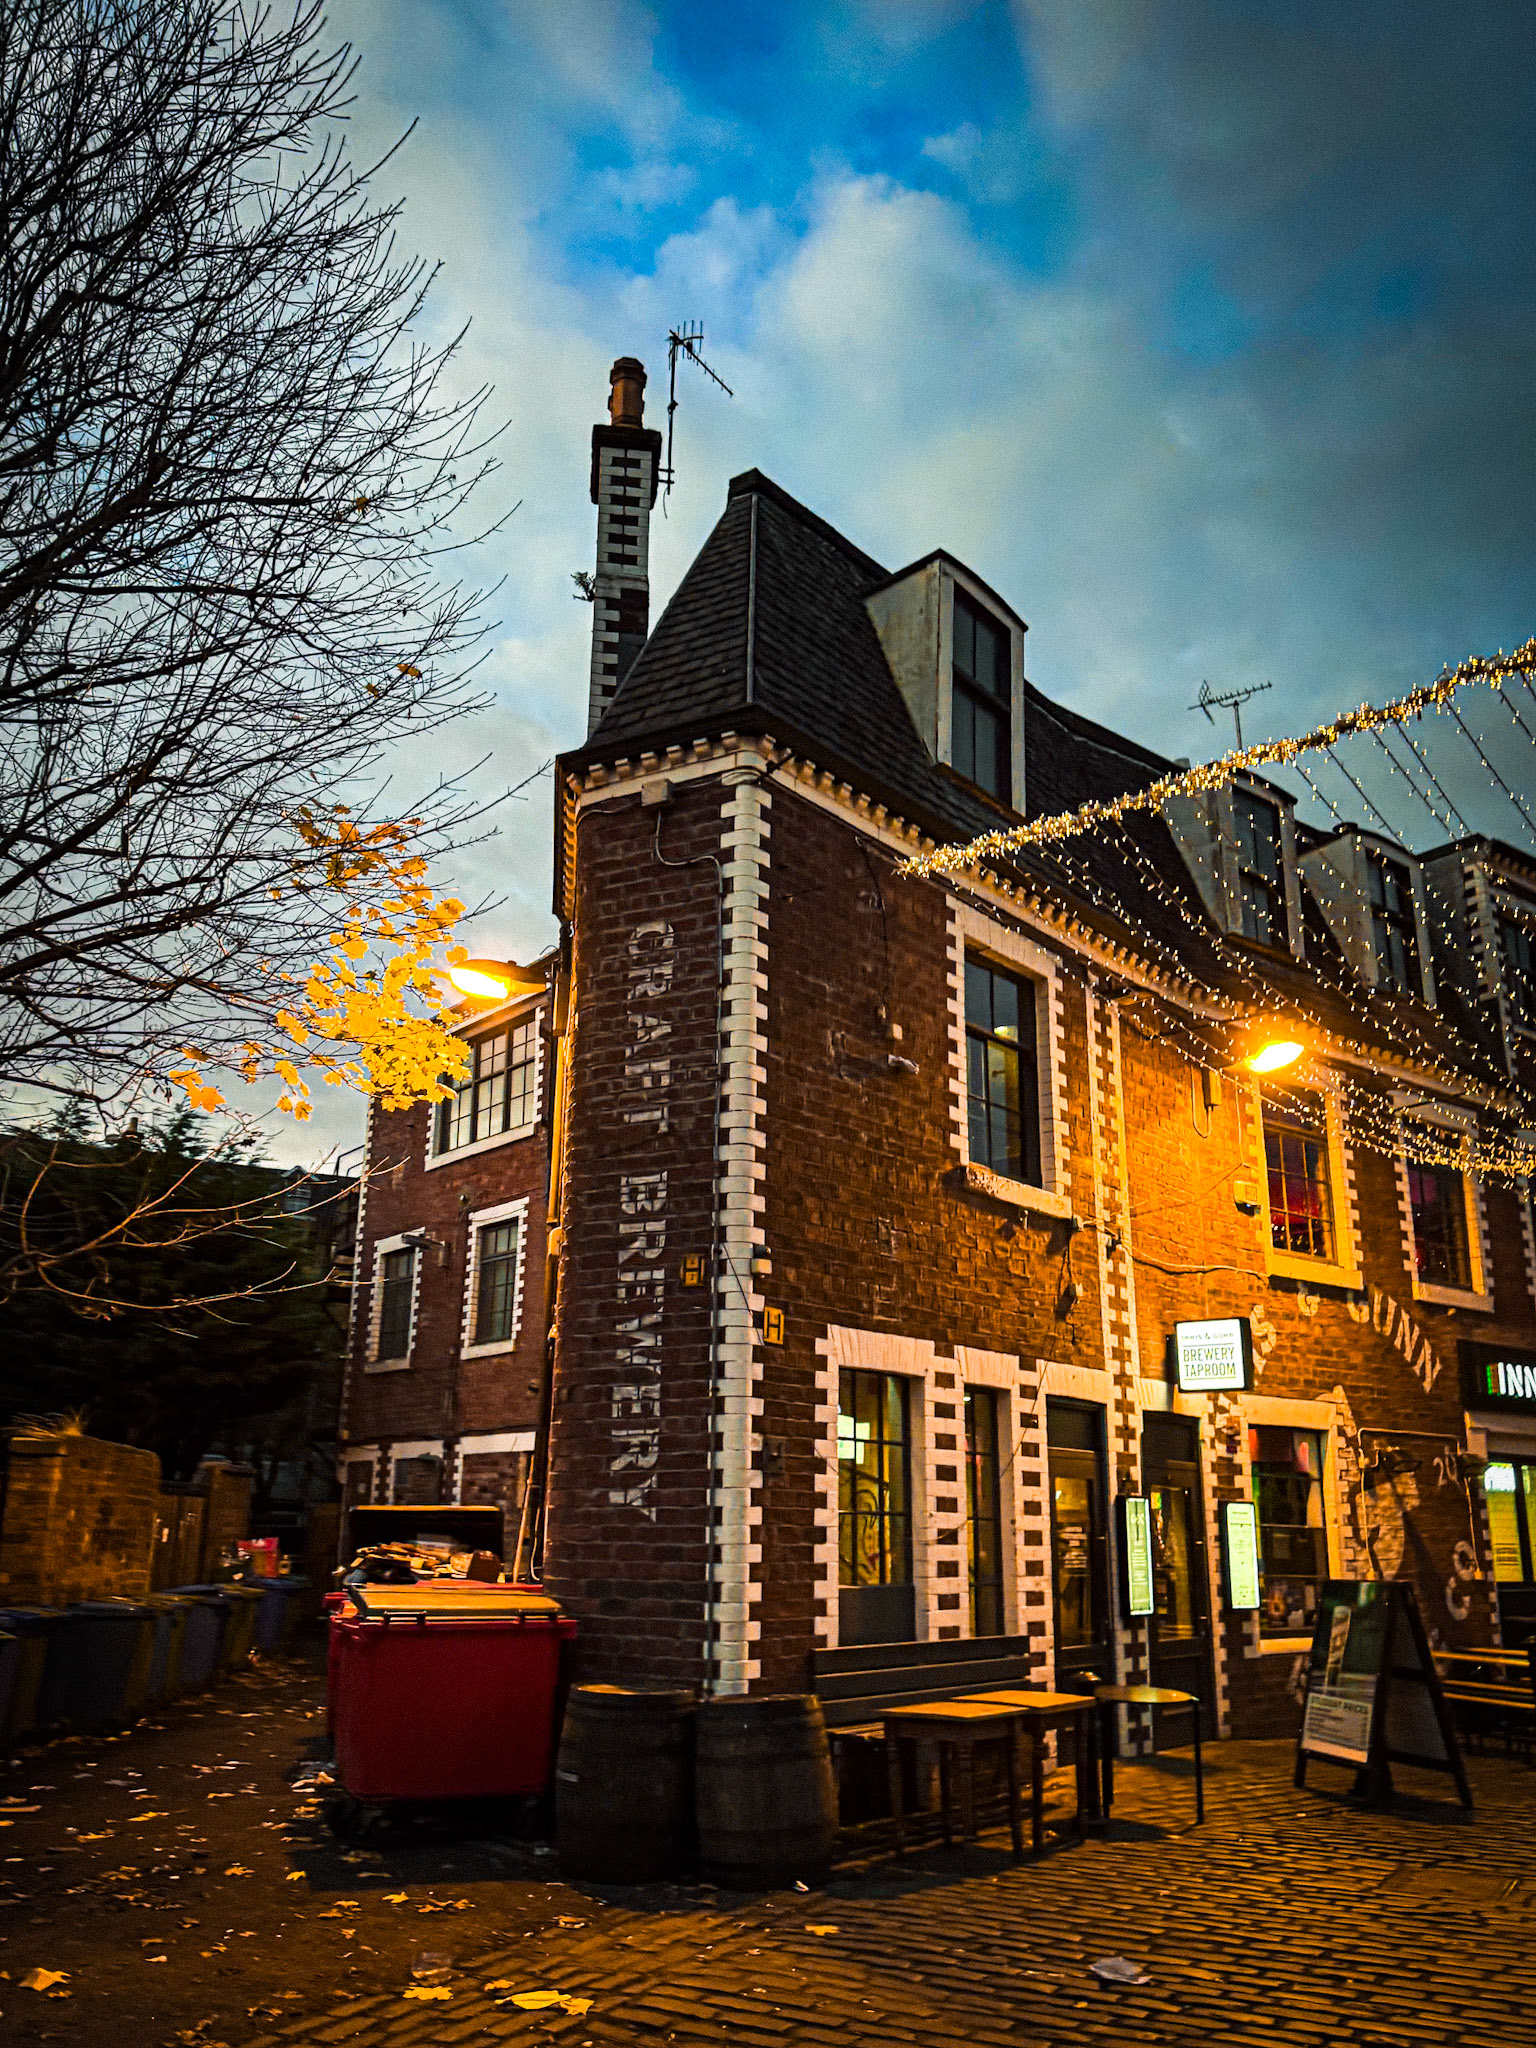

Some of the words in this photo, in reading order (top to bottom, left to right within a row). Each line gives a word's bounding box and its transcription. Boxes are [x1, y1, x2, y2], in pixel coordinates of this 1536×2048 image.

[624, 920, 675, 1134] CRAFT
[683, 1255, 702, 1284] H
[766, 1310, 781, 1342] H
[608, 1171, 667, 1522] BREWERY
[1183, 1346, 1235, 1362] BREWERY
[1184, 1362, 1236, 1377] TAPROOM
